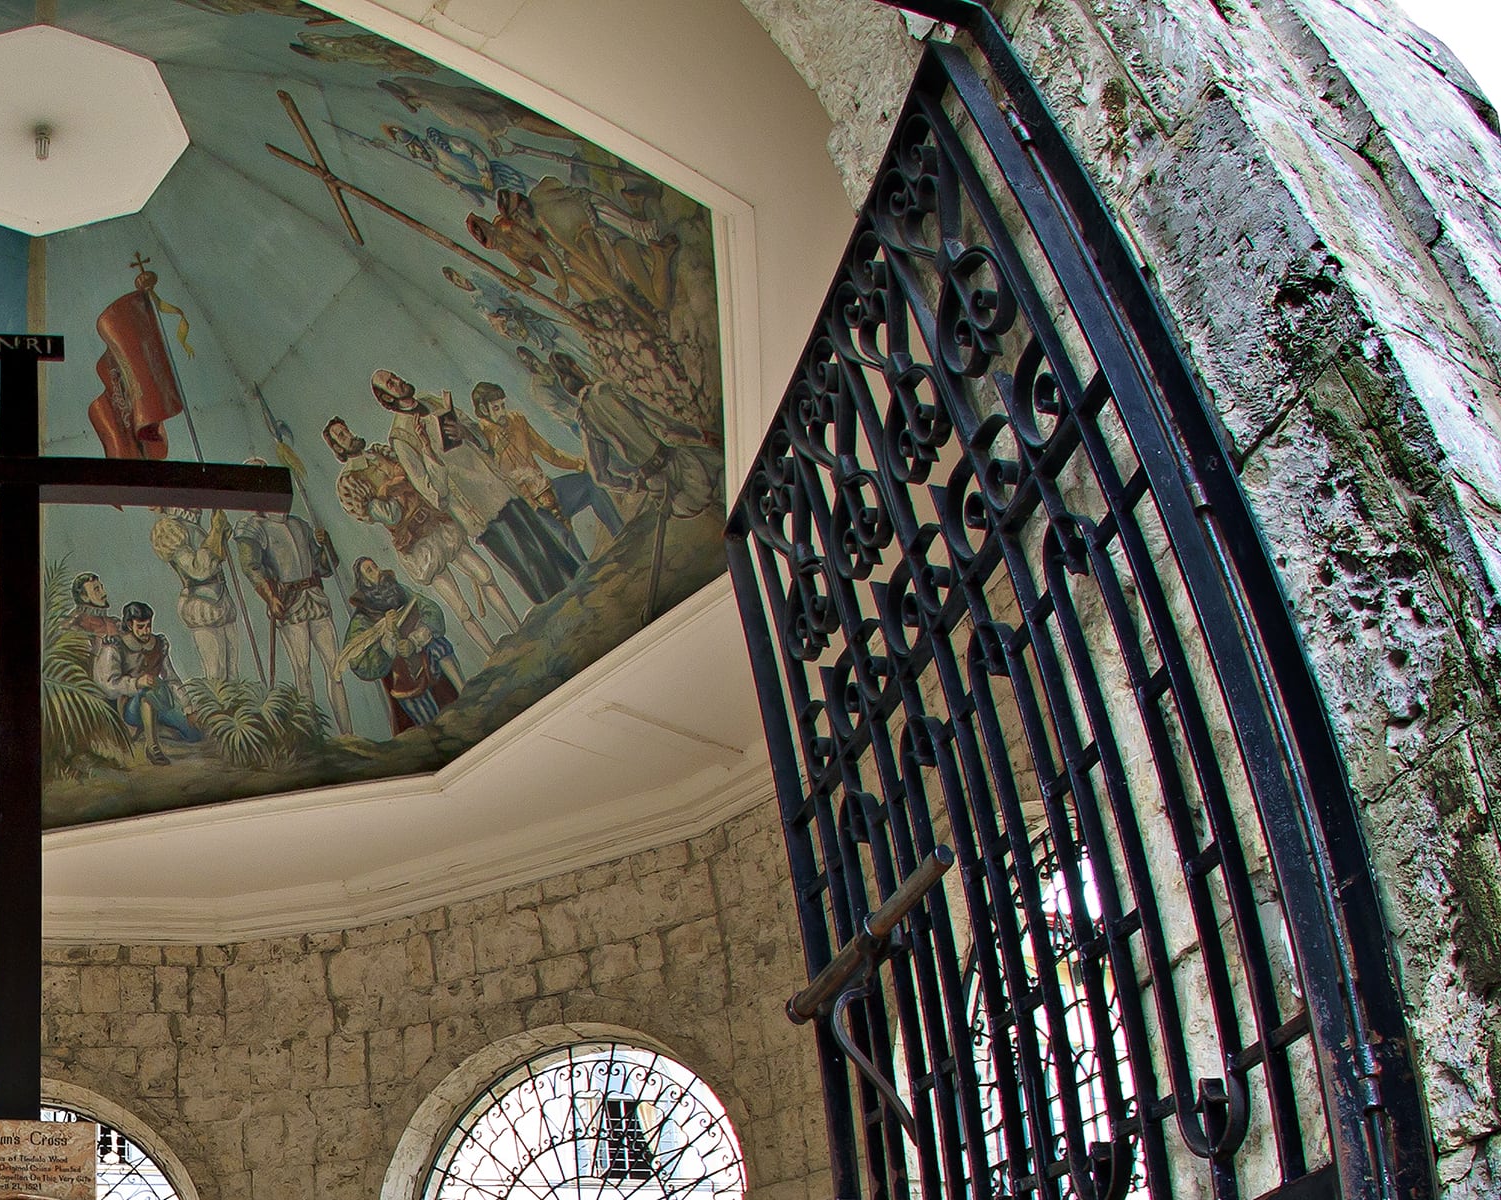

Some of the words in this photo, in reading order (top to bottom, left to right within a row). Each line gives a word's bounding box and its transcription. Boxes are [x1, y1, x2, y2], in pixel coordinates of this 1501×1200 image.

[30, 1131, 68, 1146] Cross
[48, 1155, 68, 1163] Wood
[54, 1165, 81, 1173] Planted
[30, 1173, 41, 1181] On
[42, 1174, 57, 1183] This
[59, 1175, 74, 1184] Very
[25, 1182, 42, 1191] 1521
